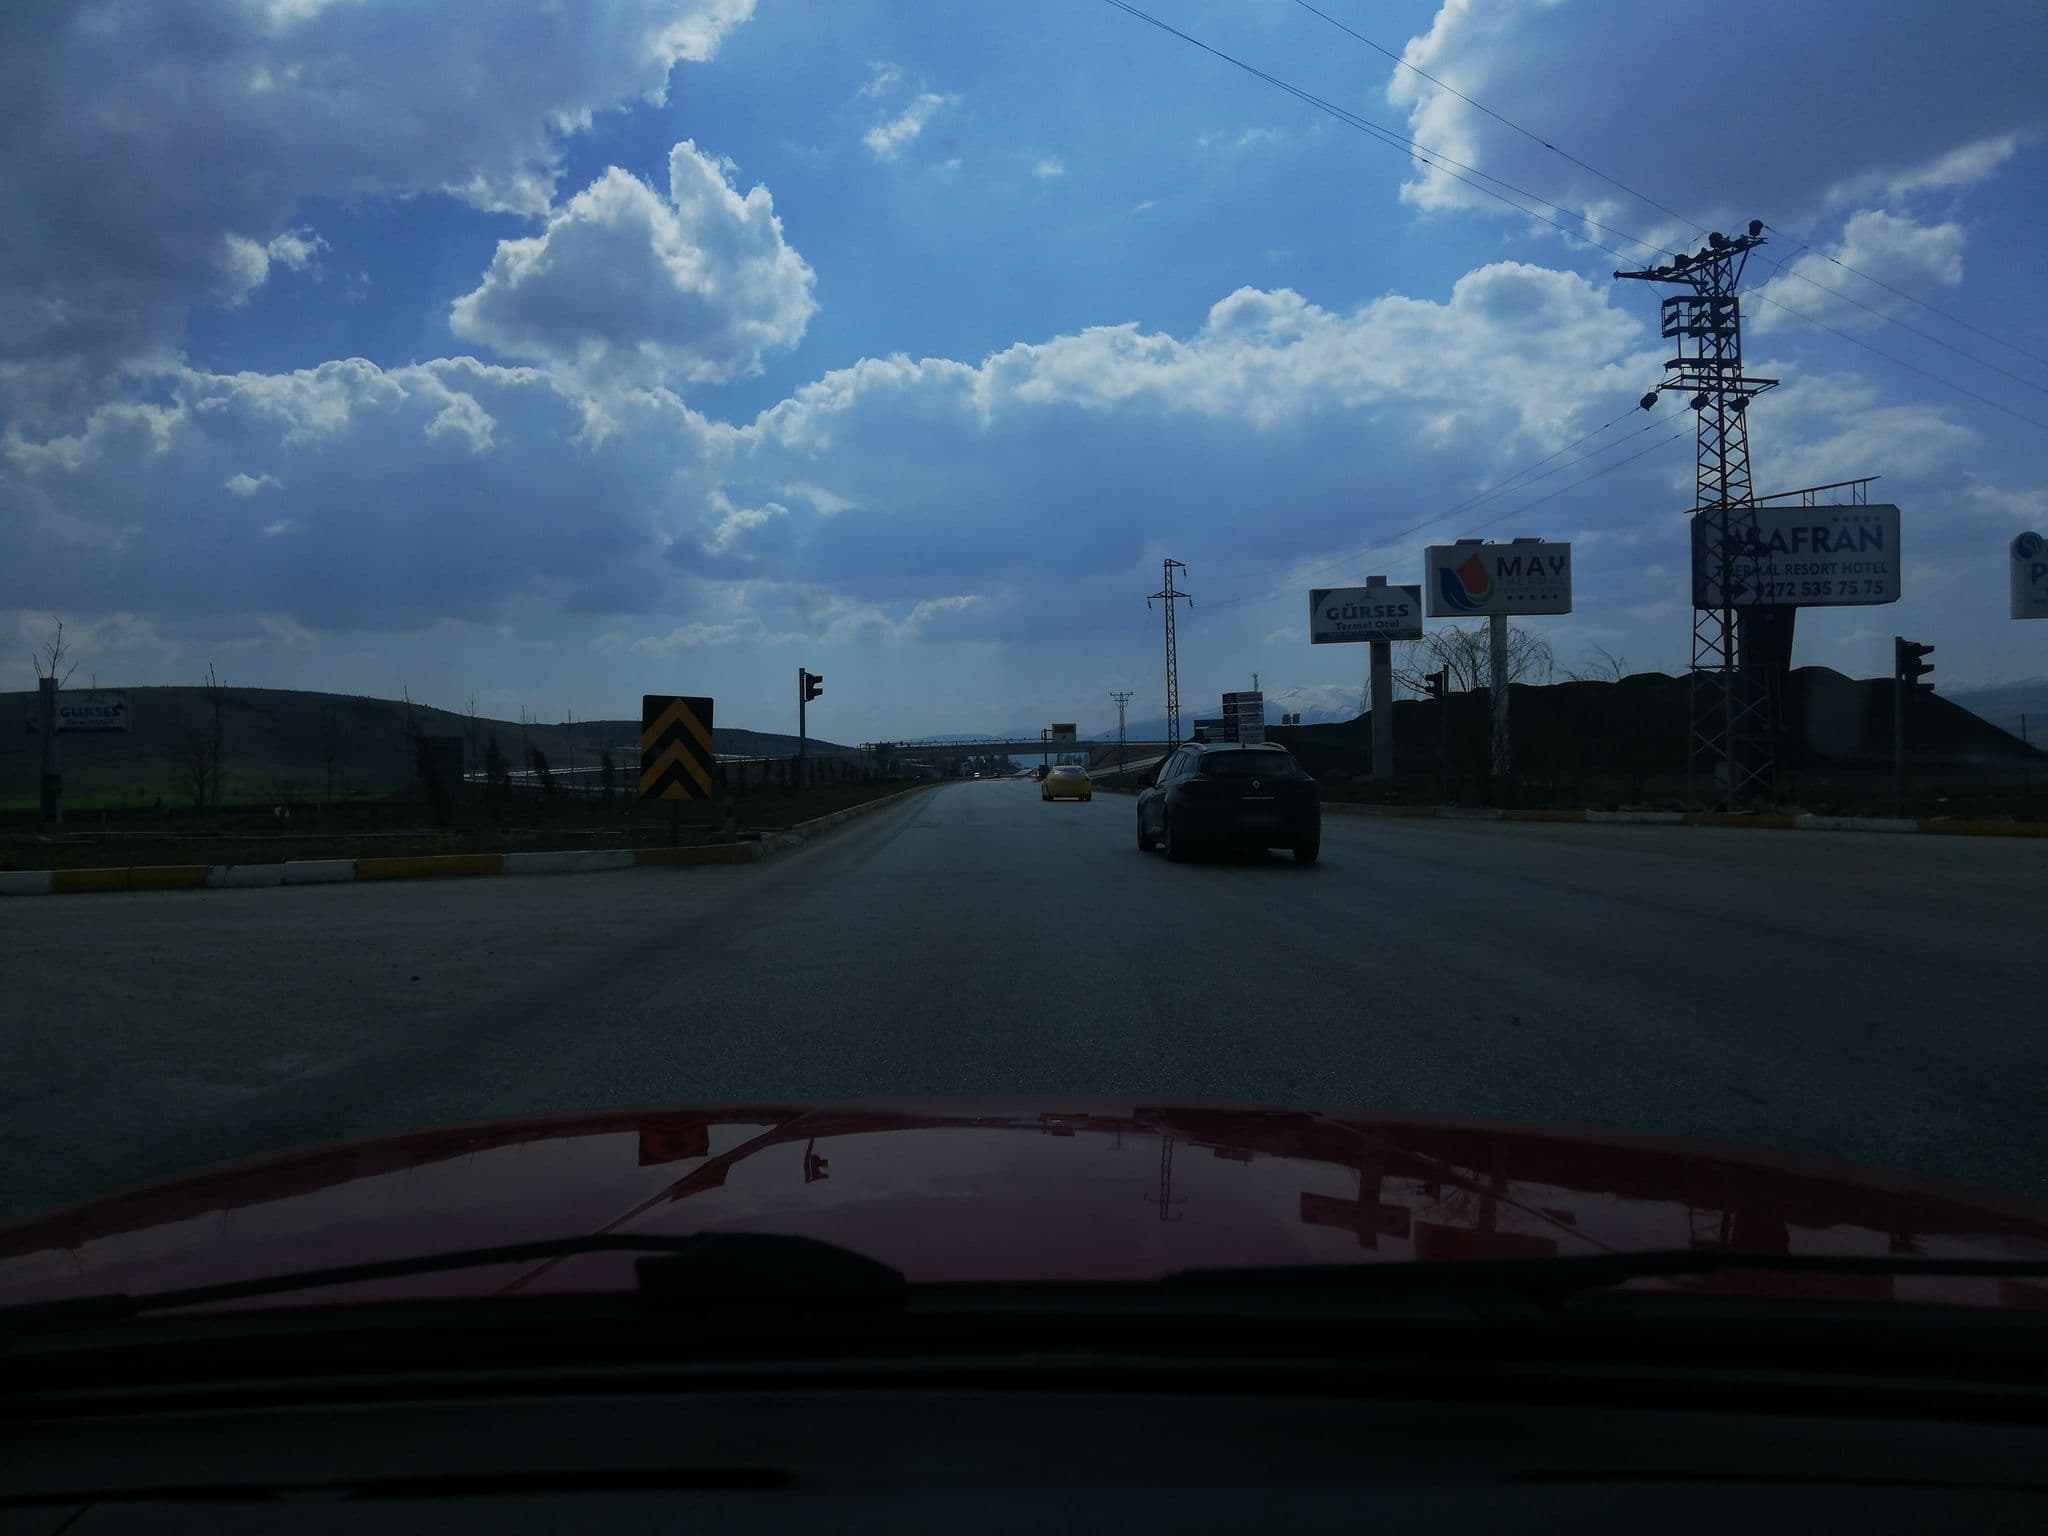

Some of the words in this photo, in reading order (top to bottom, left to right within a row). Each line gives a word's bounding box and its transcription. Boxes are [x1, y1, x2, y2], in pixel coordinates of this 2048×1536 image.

[1496, 555, 1565, 576] MAY
[1785, 562, 1836, 576] RESORT
[1842, 561, 1888, 574] HOTEL
[1801, 581, 1832, 597] 535
[1839, 580, 1858, 596] 75
[1864, 580, 1884, 595] 75
[1327, 602, 1409, 620] GÜRSES
[1375, 619, 1400, 628] Otel
